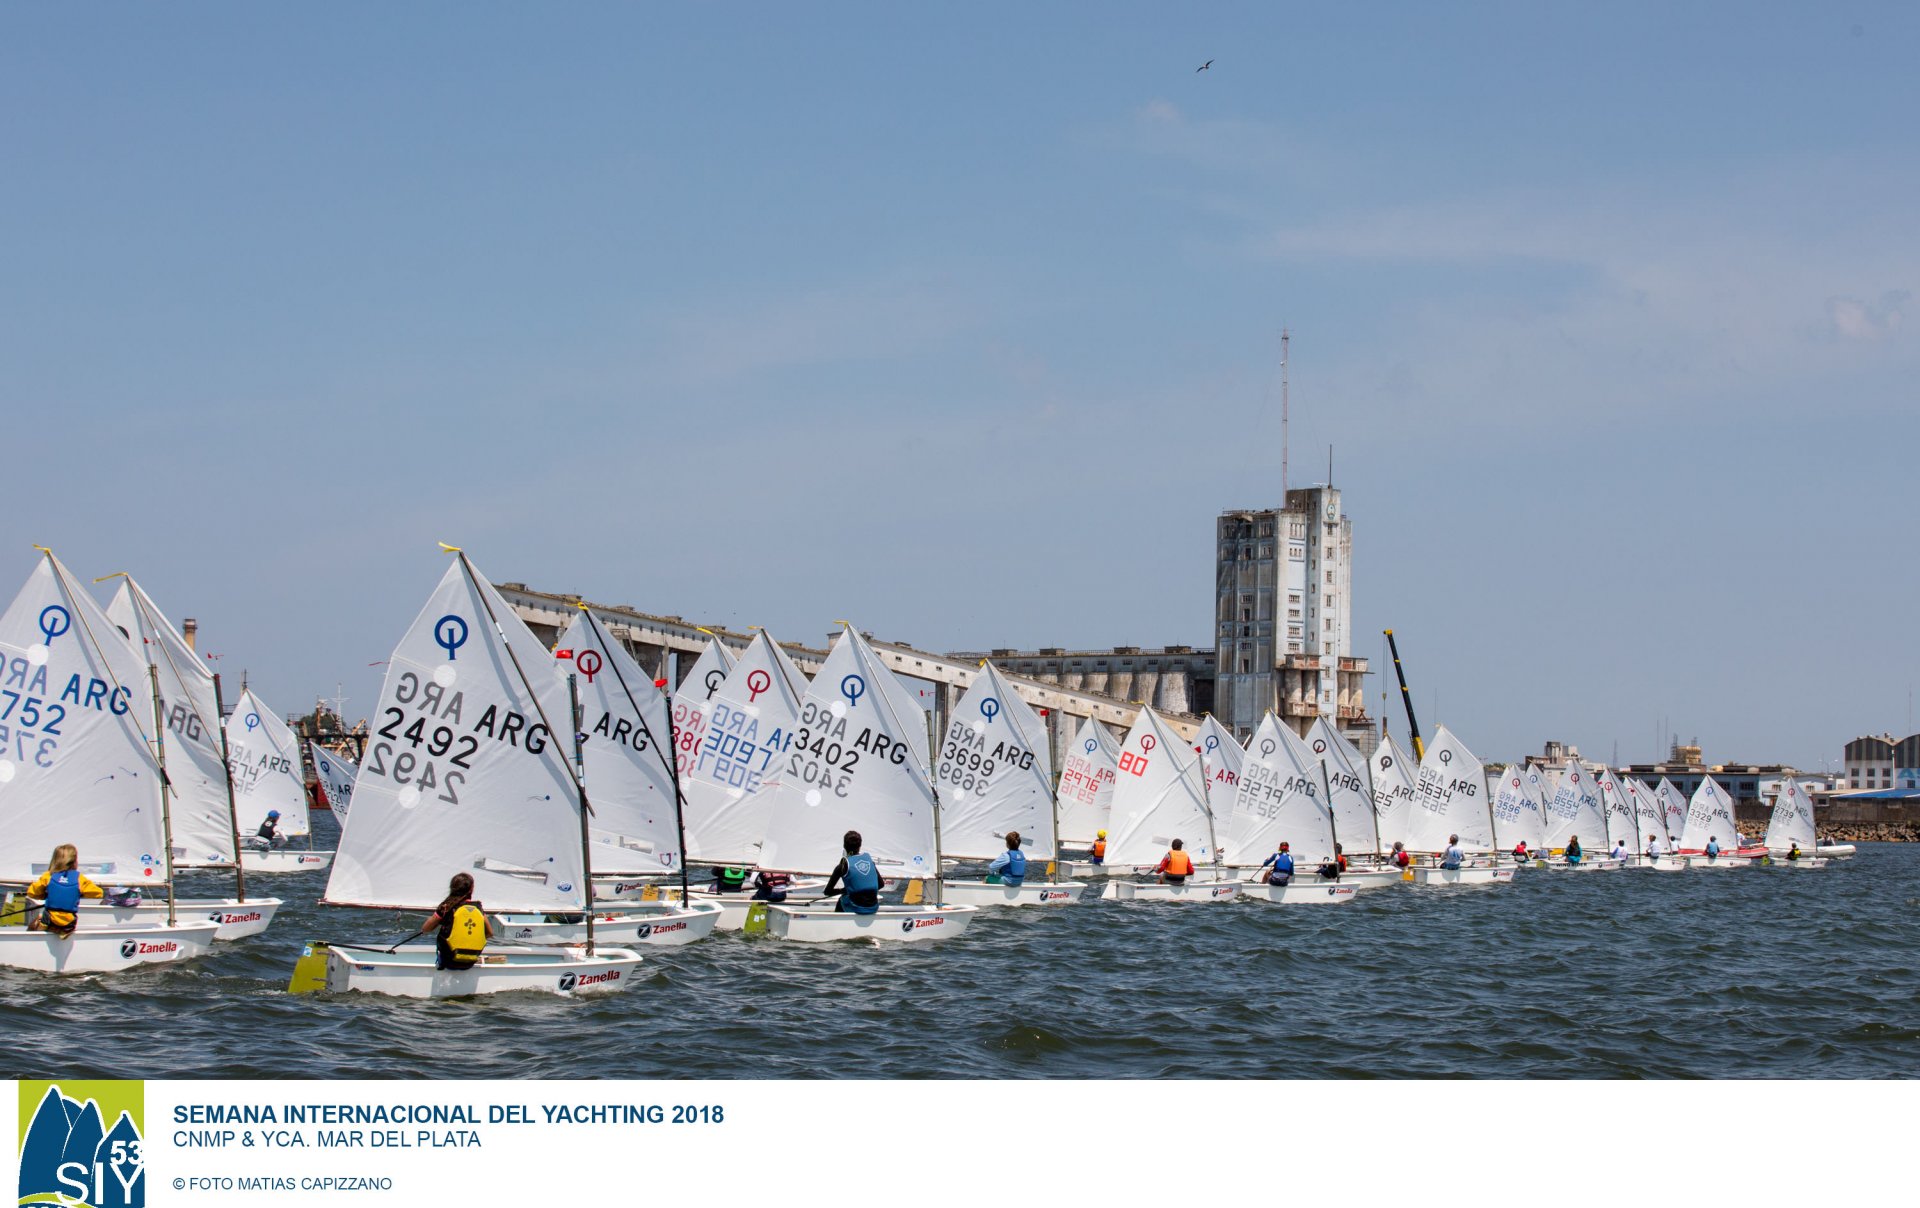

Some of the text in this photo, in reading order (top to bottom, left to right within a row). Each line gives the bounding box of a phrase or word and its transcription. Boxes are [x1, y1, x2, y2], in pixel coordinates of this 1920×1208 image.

[61, 672, 132, 716] ARG
[378, 706, 479, 770] 2492
[473, 704, 549, 755] ARG
[593, 711, 651, 752] ARG
[704, 727, 773, 771] 3097
[794, 728, 860, 774] 3402
[853, 728, 908, 765] ARG
[991, 741, 1035, 771] ARG
[258, 754, 291, 775] ARG
[944, 741, 995, 777] 3699
[1064, 769, 1100, 793] 2976
[1283, 775, 1317, 798] ARG
[1330, 772, 1361, 793] ARG
[1417, 778, 1452, 803] 3634
[1448, 778, 1477, 797] ARG
[1496, 800, 1520, 815] 3596
[1518, 798, 1538, 811] ARG
[1578, 794, 1598, 809] ARG
[1610, 802, 1630, 816] ARG
[1666, 805, 1683, 817] ARG
[1689, 808, 1712, 823] 3329
[1711, 808, 1729, 819] ARG
[1774, 805, 1794, 819] 2739
[1049, 891, 1070, 899] Zanella
[225, 912, 261, 924] Zanella
[915, 916, 944, 928] Zanella
[653, 921, 687, 935] Zanella
[139, 941, 177, 954] Zanella
[578, 969, 621, 986] Zanella
